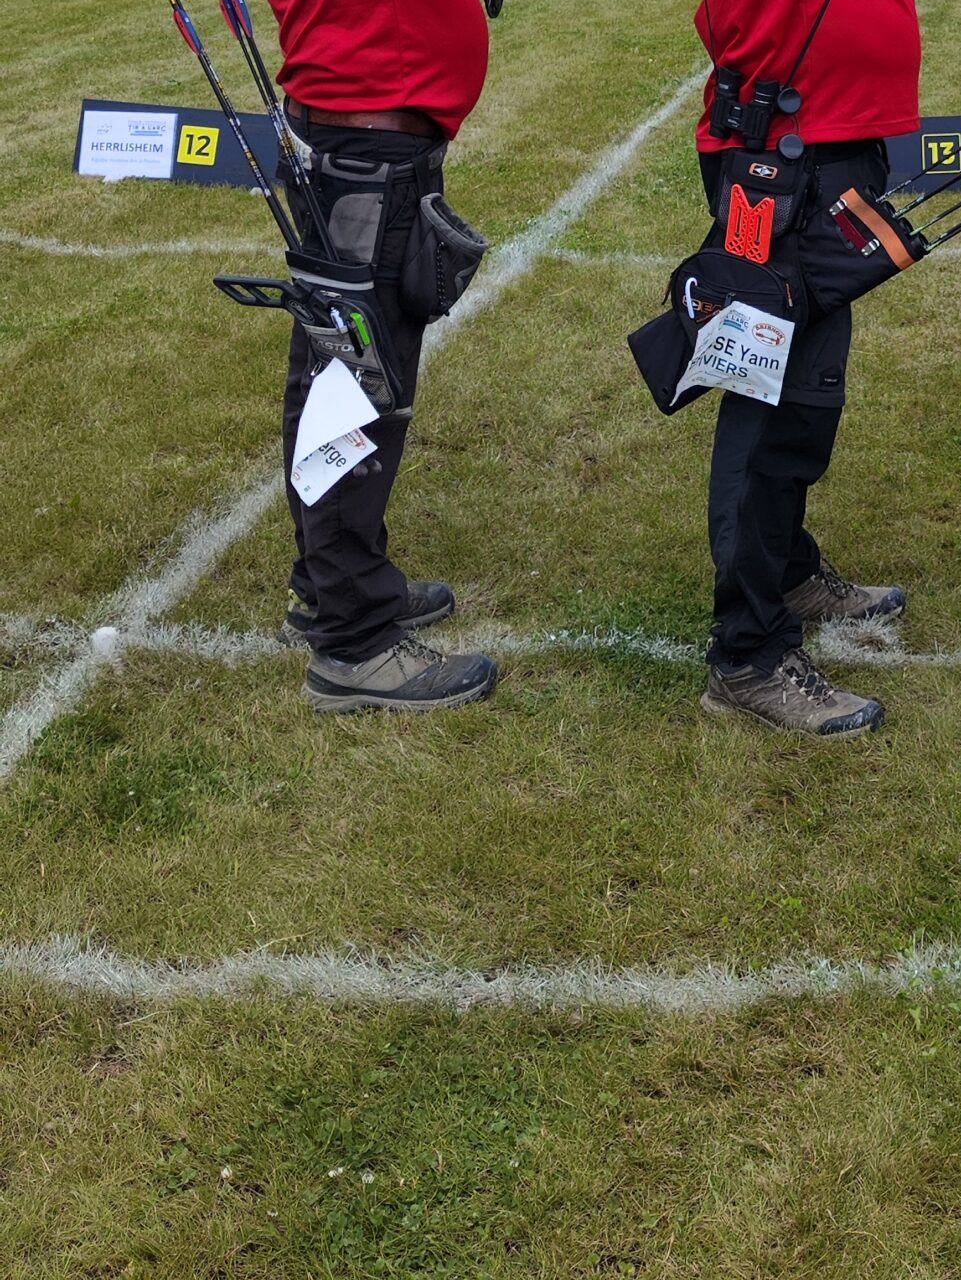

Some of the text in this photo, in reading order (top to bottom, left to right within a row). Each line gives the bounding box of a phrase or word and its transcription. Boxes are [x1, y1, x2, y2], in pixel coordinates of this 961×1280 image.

[91, 142, 163, 153] HERRLISHEIM
[185, 134, 211, 156] 12
[928, 142, 955, 165] 13
[711, 336, 779, 370] SE Yann
[700, 353, 749, 379] VIERS
[319, 442, 347, 468] erge
